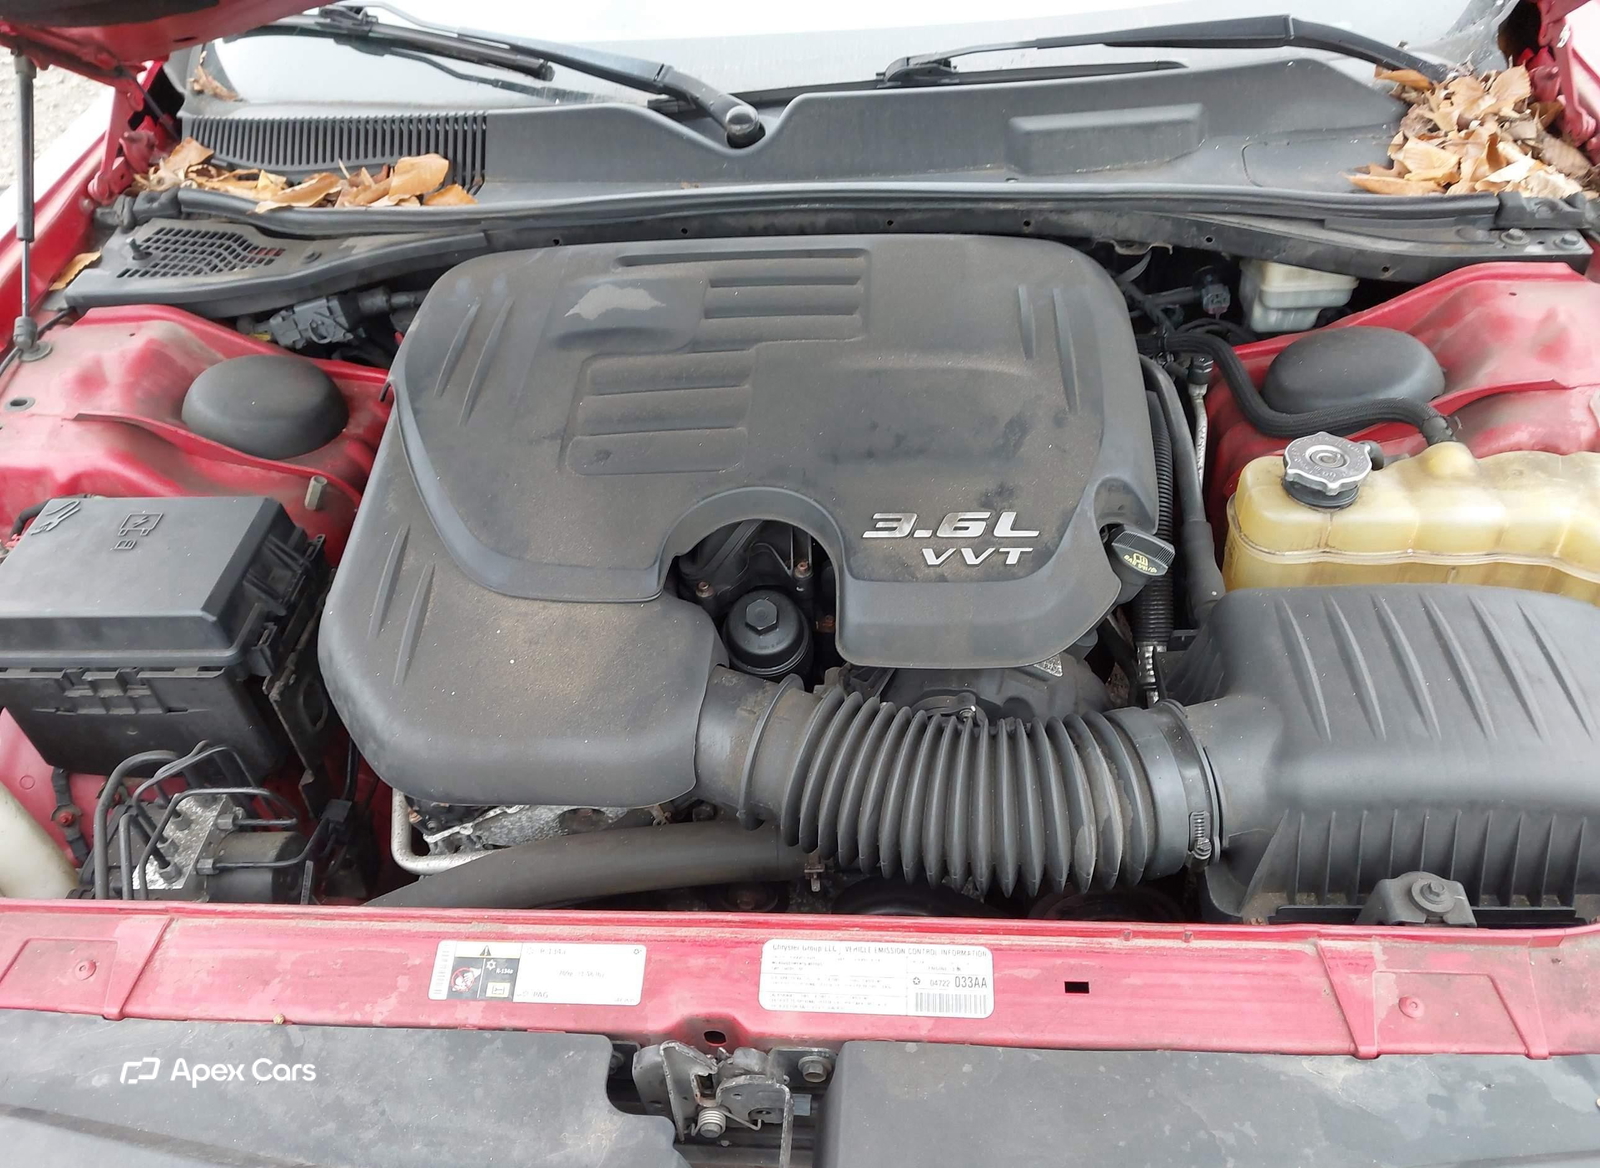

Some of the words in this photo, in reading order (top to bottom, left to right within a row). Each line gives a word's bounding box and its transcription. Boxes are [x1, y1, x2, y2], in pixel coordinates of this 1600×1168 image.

[862, 511, 1040, 538] 3.6L
[922, 548, 1034, 565] VVT
[802, 945, 822, 953] Group
[874, 946, 906, 954] EMISSION
[908, 948, 938, 956] CONTROL
[940, 949, 987, 957] INFORMATION
[929, 979, 951, 987] 04722
[954, 975, 988, 989] 033AA
